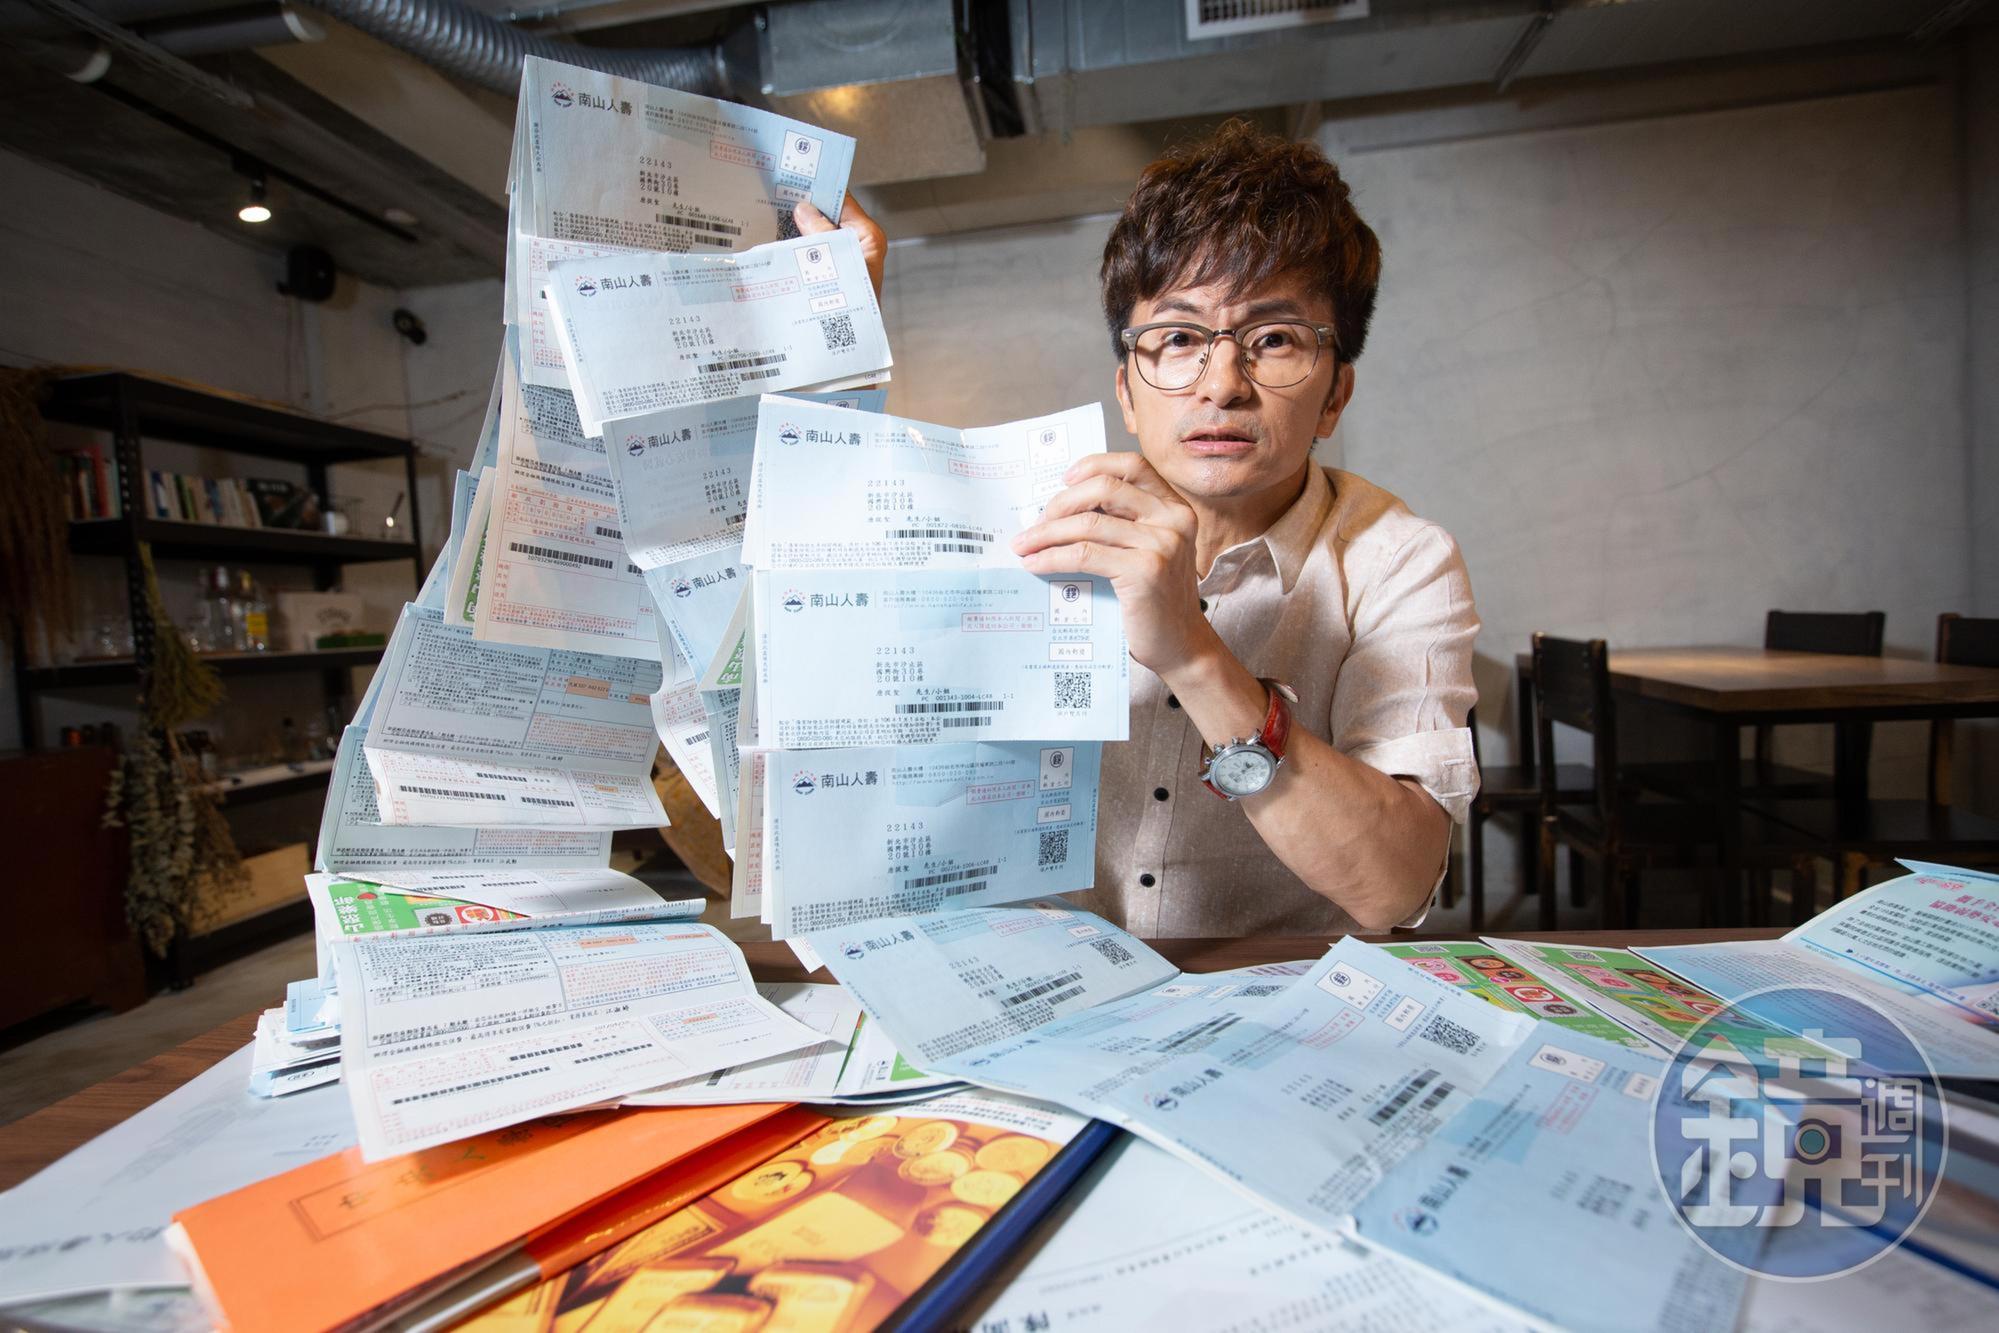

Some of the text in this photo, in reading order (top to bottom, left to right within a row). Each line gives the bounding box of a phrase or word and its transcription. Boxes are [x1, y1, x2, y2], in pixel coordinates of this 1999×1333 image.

[578, 92, 633, 117] 南山人壽
[639, 156, 672, 169] 22143
[600, 274, 652, 291] 南山人壽
[668, 315, 701, 325] 22143
[647, 427, 692, 449] 南山人壽
[806, 429, 861, 446] 南山人壽
[702, 467, 731, 481] 22143
[867, 479, 905, 487] 22143
[692, 566, 737, 590] 南山人壽
[809, 592, 869, 608] 南山人壽
[876, 646, 915, 655] 22143
[821, 771, 878, 789] 南山人壽
[886, 822, 924, 832] 22143
[864, 929, 915, 952] 南山人壽
